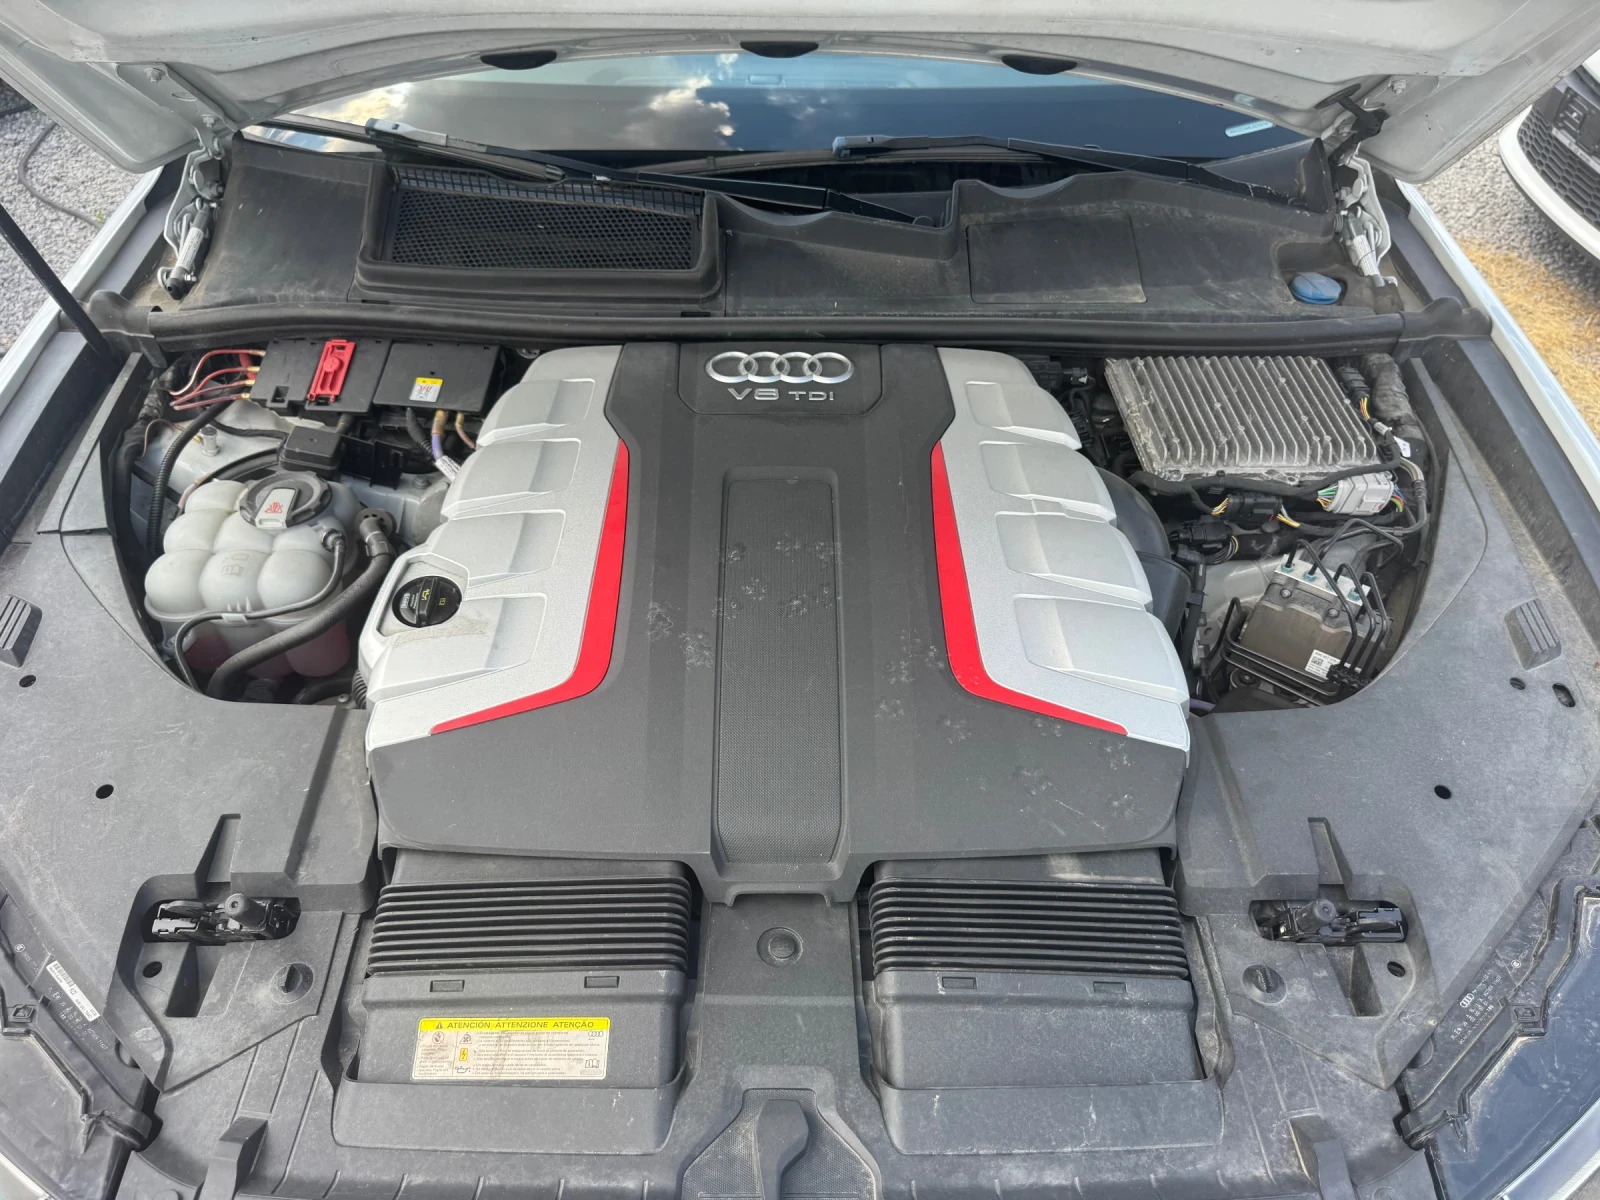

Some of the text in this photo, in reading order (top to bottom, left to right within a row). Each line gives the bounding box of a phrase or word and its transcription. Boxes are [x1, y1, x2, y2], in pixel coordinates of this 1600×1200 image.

[728, 388, 834, 401] V8 TDI
[447, 1020, 594, 1029] ATENCIÓN ATTENZIONE ATENÇÃO
